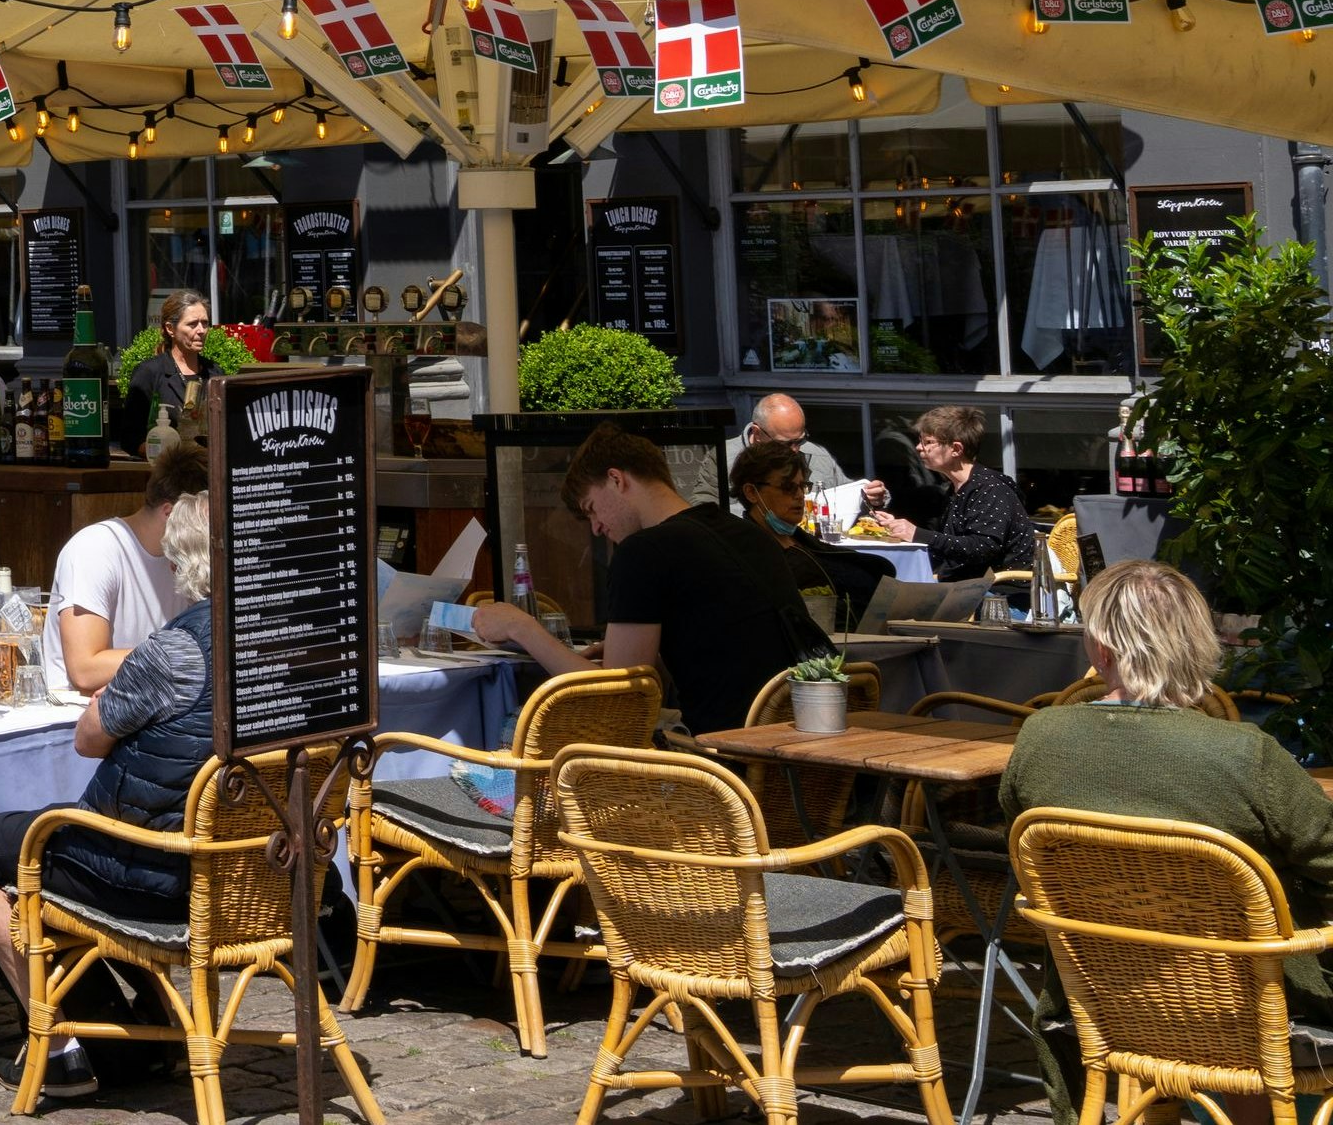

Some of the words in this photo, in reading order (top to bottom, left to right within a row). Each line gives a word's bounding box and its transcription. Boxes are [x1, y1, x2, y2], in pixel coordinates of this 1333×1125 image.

[916, 5, 955, 33] Carlsberg
[368, 52, 401, 67] Carlsberg
[498, 43, 532, 63] Carlsberg
[239, 70, 267, 83] Carlsberg
[694, 80, 738, 99] Carlsberg
[605, 207, 630, 228] LUNCH
[631, 206, 658, 226] DISHES
[1171, 230, 1197, 238] VORES
[245, 390, 289, 442] LUNCH
[293, 389, 338, 434] DISHES
